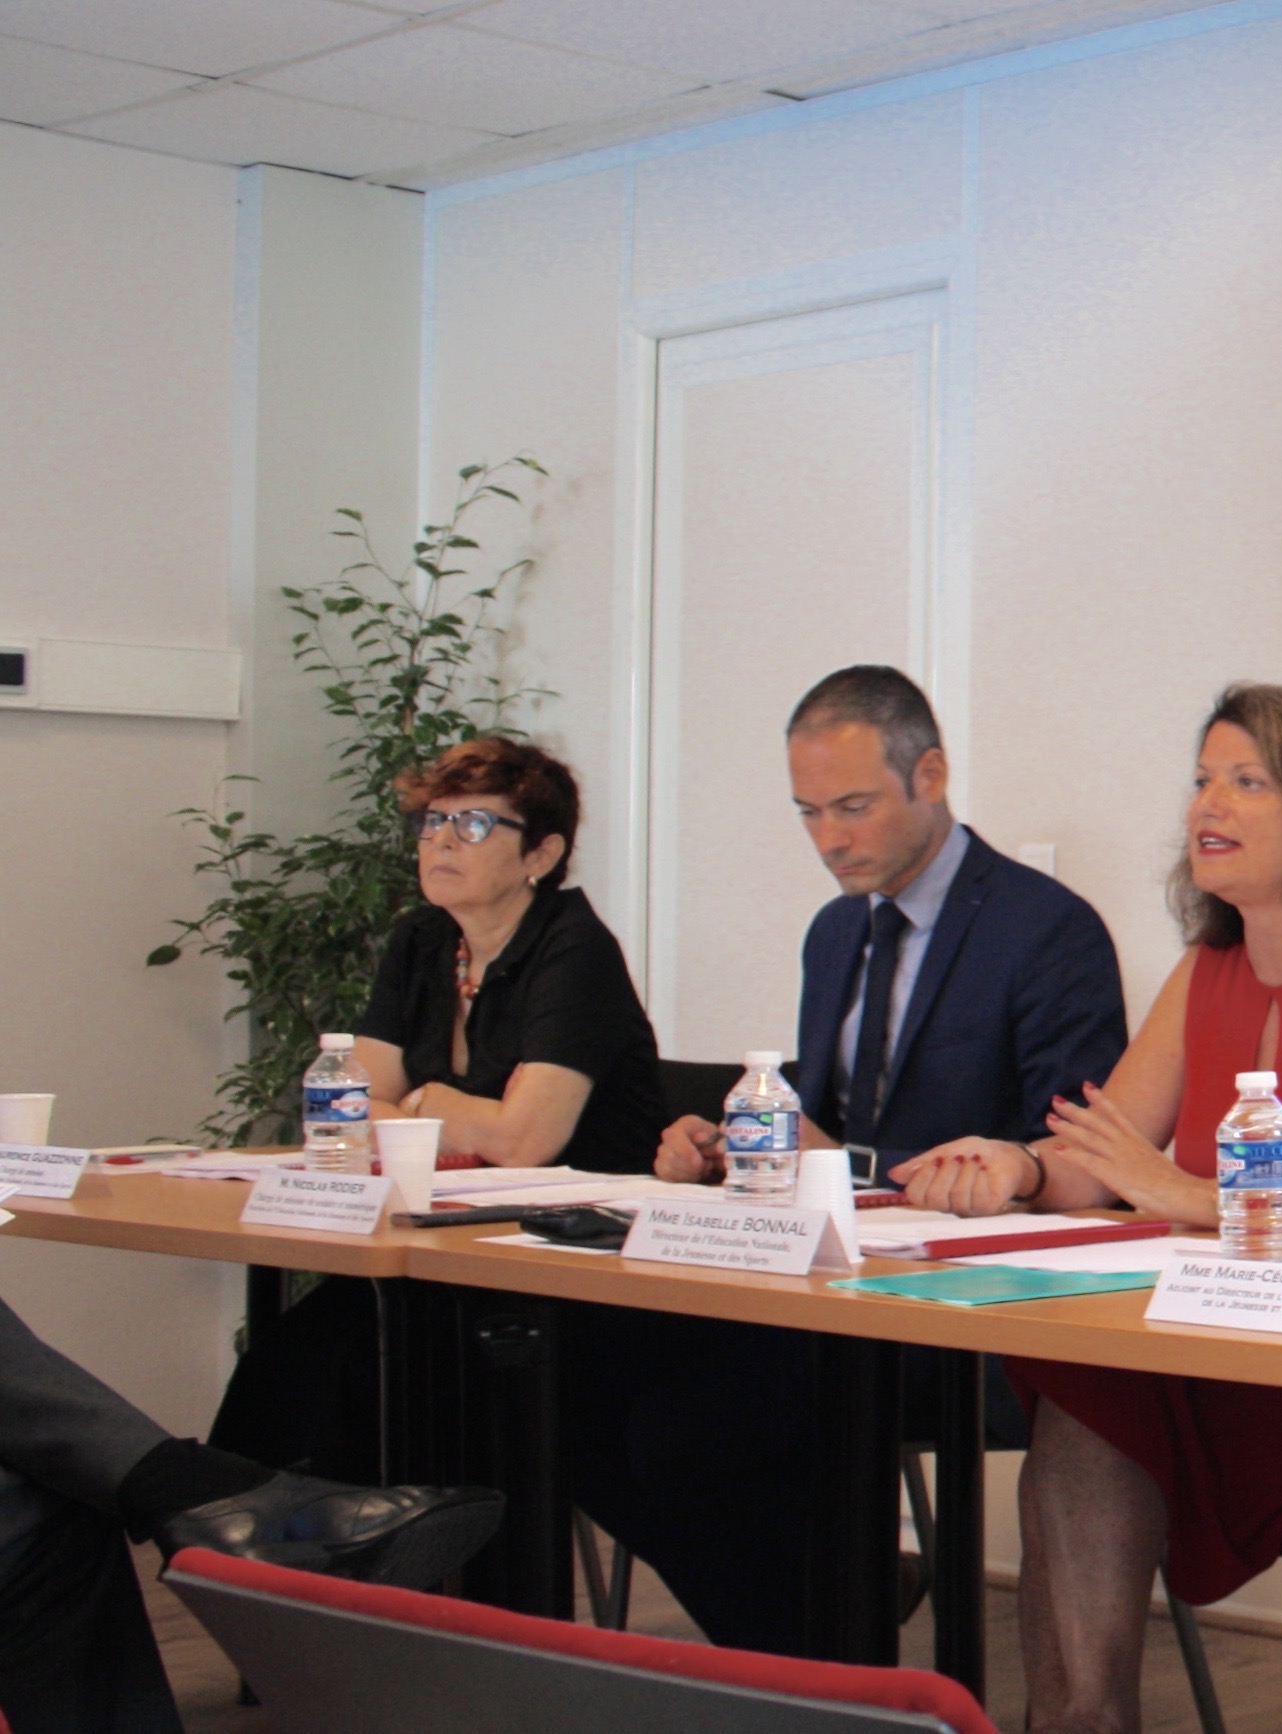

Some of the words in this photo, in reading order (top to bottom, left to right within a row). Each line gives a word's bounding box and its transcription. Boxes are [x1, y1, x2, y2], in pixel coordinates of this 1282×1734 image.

[293, 1178, 327, 1191] NICOLAS
[329, 1181, 366, 1195] RODIER
[682, 1211, 740, 1231] ISABELLE
[742, 1217, 809, 1237] BONNAL
[1166, 1282, 1202, 1294] ADJOINT
[1203, 1286, 1215, 1295] AU
[1216, 1286, 1262, 1299] DIRECTEUR
[1263, 1291, 1276, 1300] DE
[1201, 1299, 1213, 1308] DE
[1214, 1300, 1226, 1309] LA
[1228, 1300, 1269, 1313] JEUNESSE
[1270, 1305, 1282, 1314] ET
